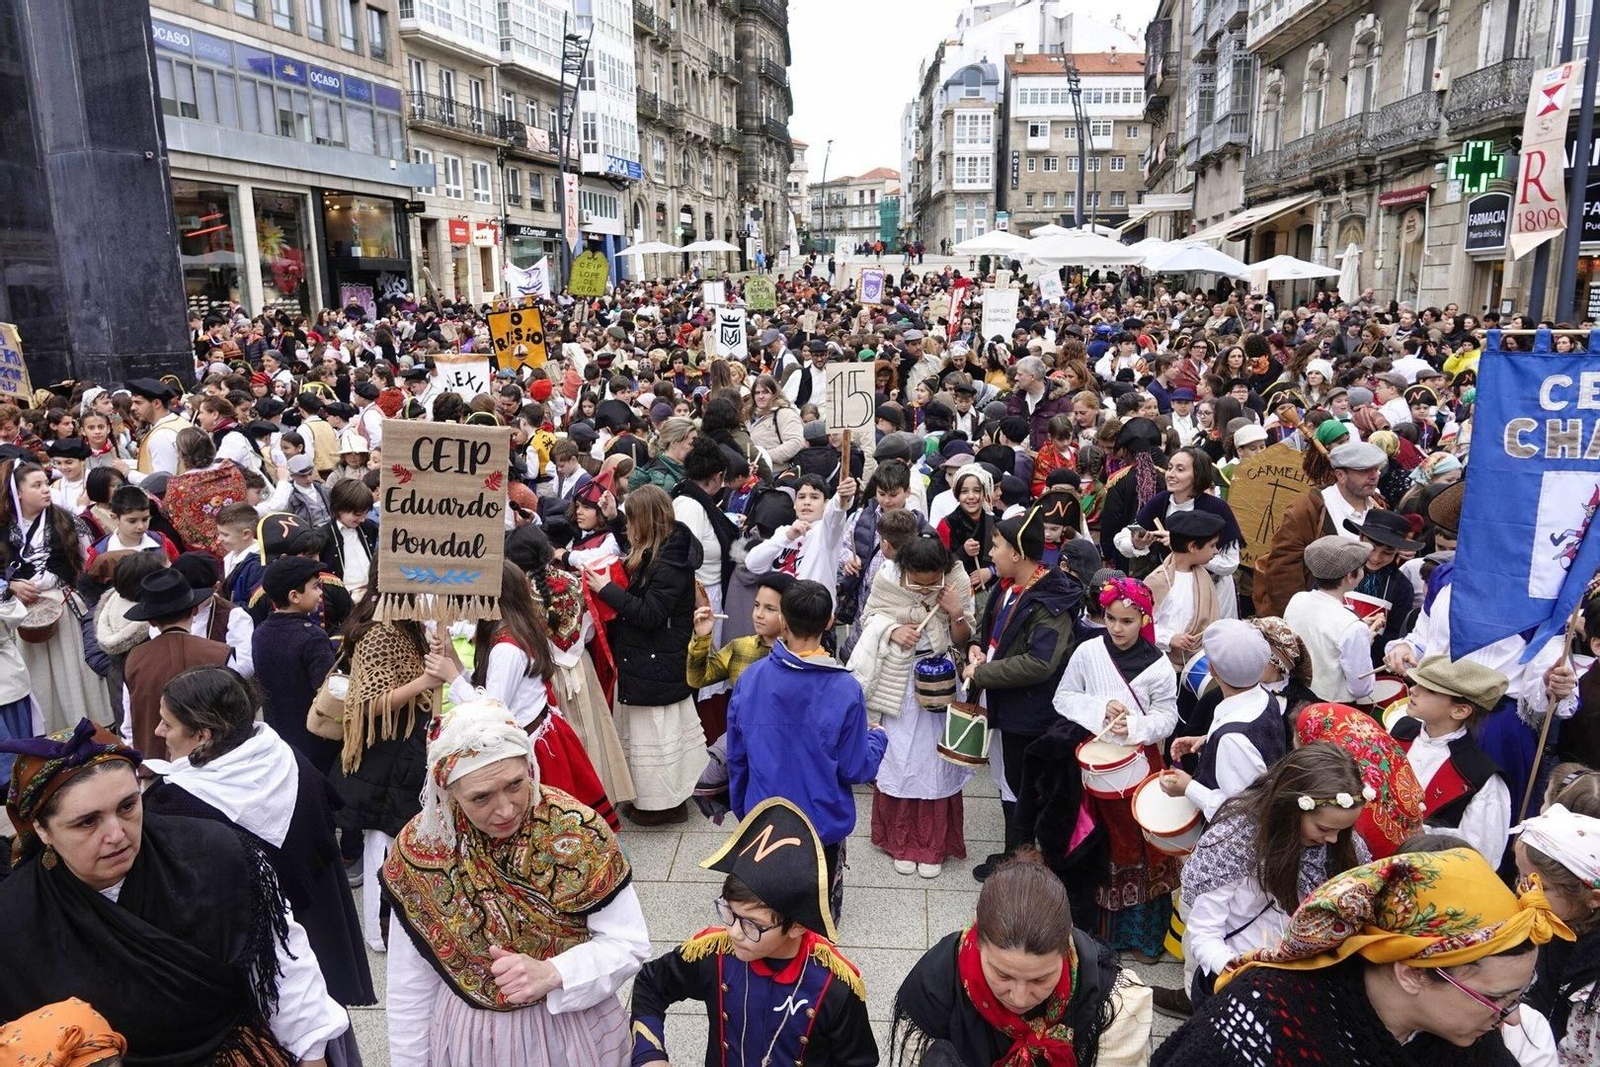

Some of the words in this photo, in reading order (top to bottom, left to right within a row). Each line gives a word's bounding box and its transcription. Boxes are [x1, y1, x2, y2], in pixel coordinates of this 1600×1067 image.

[152, 26, 190, 47] OCASO
[310, 71, 340, 88] OCASO
[1519, 150, 1556, 204] R
[1469, 210, 1505, 226] FARMACIA
[1517, 208, 1560, 232] 1809
[580, 271, 600, 279] LOPE
[510, 312, 523, 326] O
[828, 370, 874, 429] 15
[412, 437, 491, 475] CEIP
[385, 487, 502, 519] Eduardo
[1045, 501, 1073, 518] N
[391, 528, 487, 558] Pondal
[739, 825, 801, 862] N
[773, 995, 808, 1015] N
